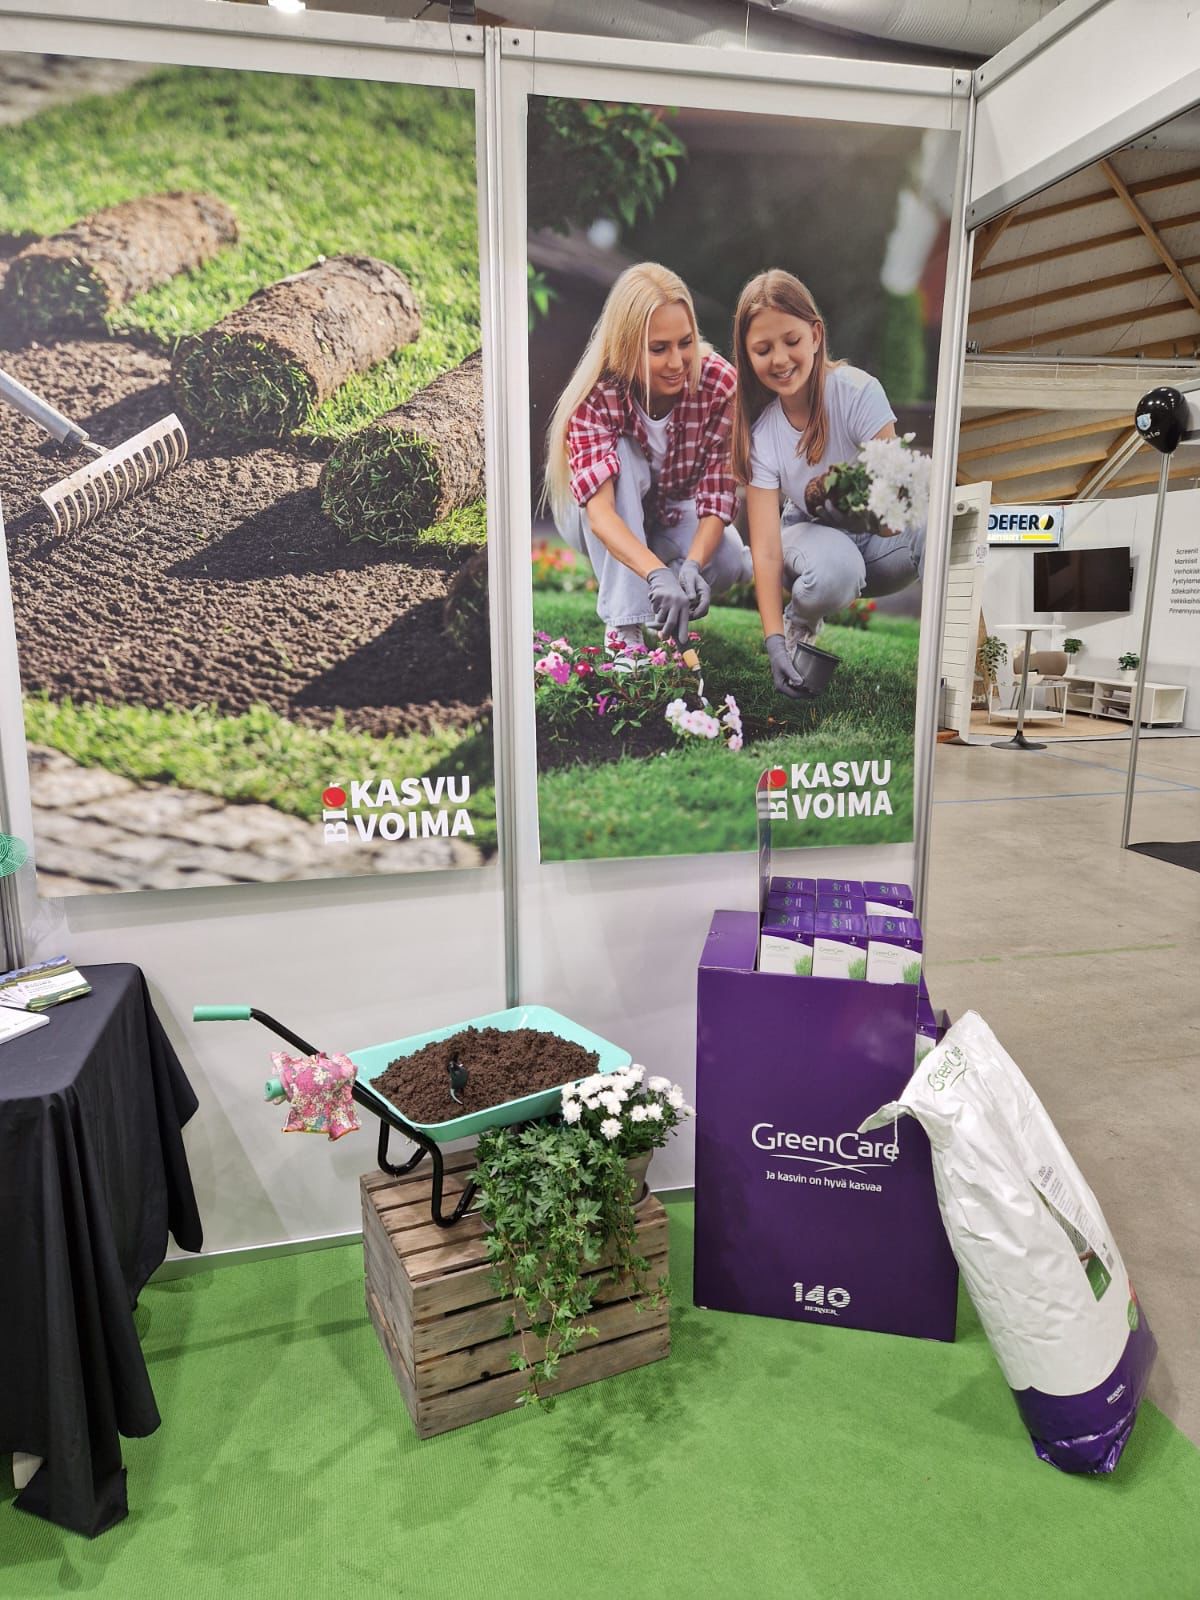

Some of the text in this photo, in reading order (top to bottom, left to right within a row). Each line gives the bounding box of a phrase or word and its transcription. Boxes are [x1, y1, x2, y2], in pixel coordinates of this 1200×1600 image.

[791, 759, 892, 789] KASVU
[350, 775, 471, 809] KASVU
[791, 790, 894, 820] VOIMA
[352, 808, 476, 842] VOIMA
[927, 1046, 964, 1092] GreenCare
[751, 1122, 900, 1161] GreenCare
[766, 1170, 882, 1192] Ja kasvin on hyvä kasvaa
[792, 1282, 851, 1308] 140
